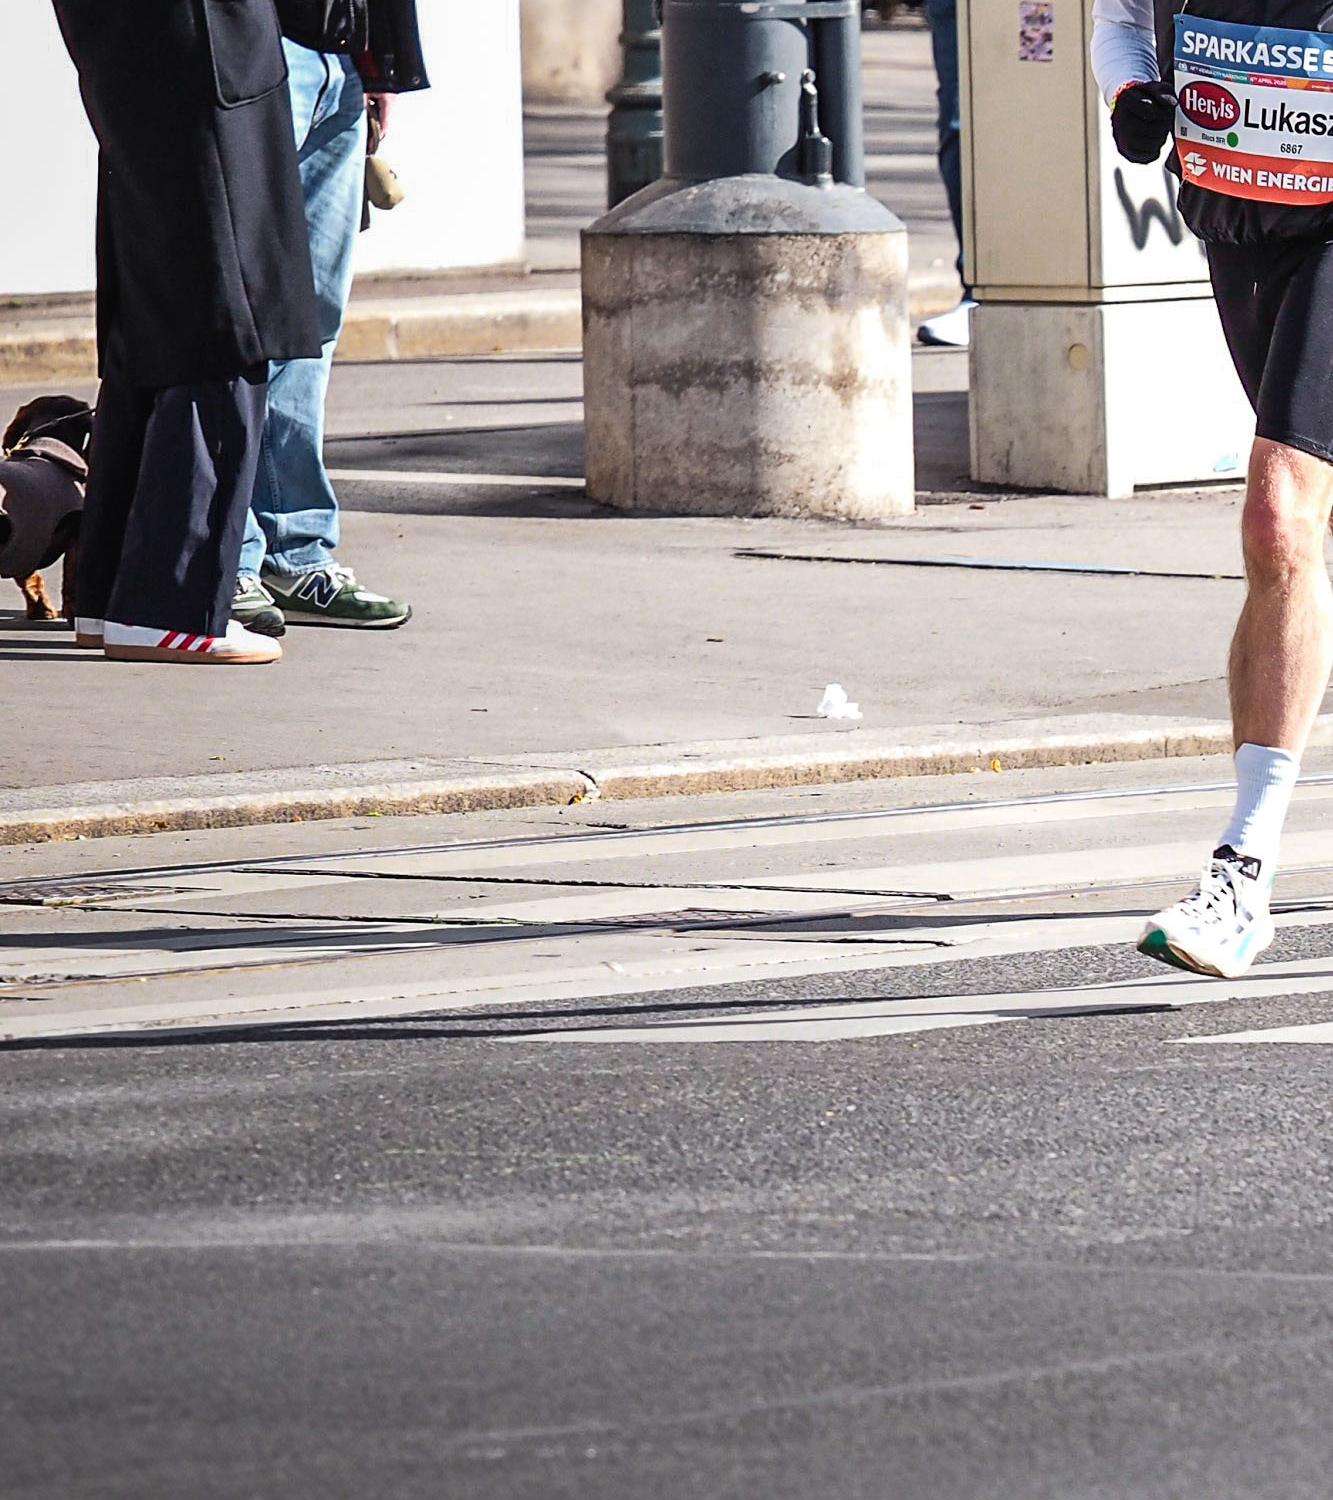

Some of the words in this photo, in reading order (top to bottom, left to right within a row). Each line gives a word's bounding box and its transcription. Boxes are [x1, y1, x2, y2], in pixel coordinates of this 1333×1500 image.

[1181, 29, 1321, 73] SPARKASSE
[1185, 87, 1235, 121] Hervis
[1280, 142, 1303, 155] 6867
[1211, 161, 1252, 184] WIEN
